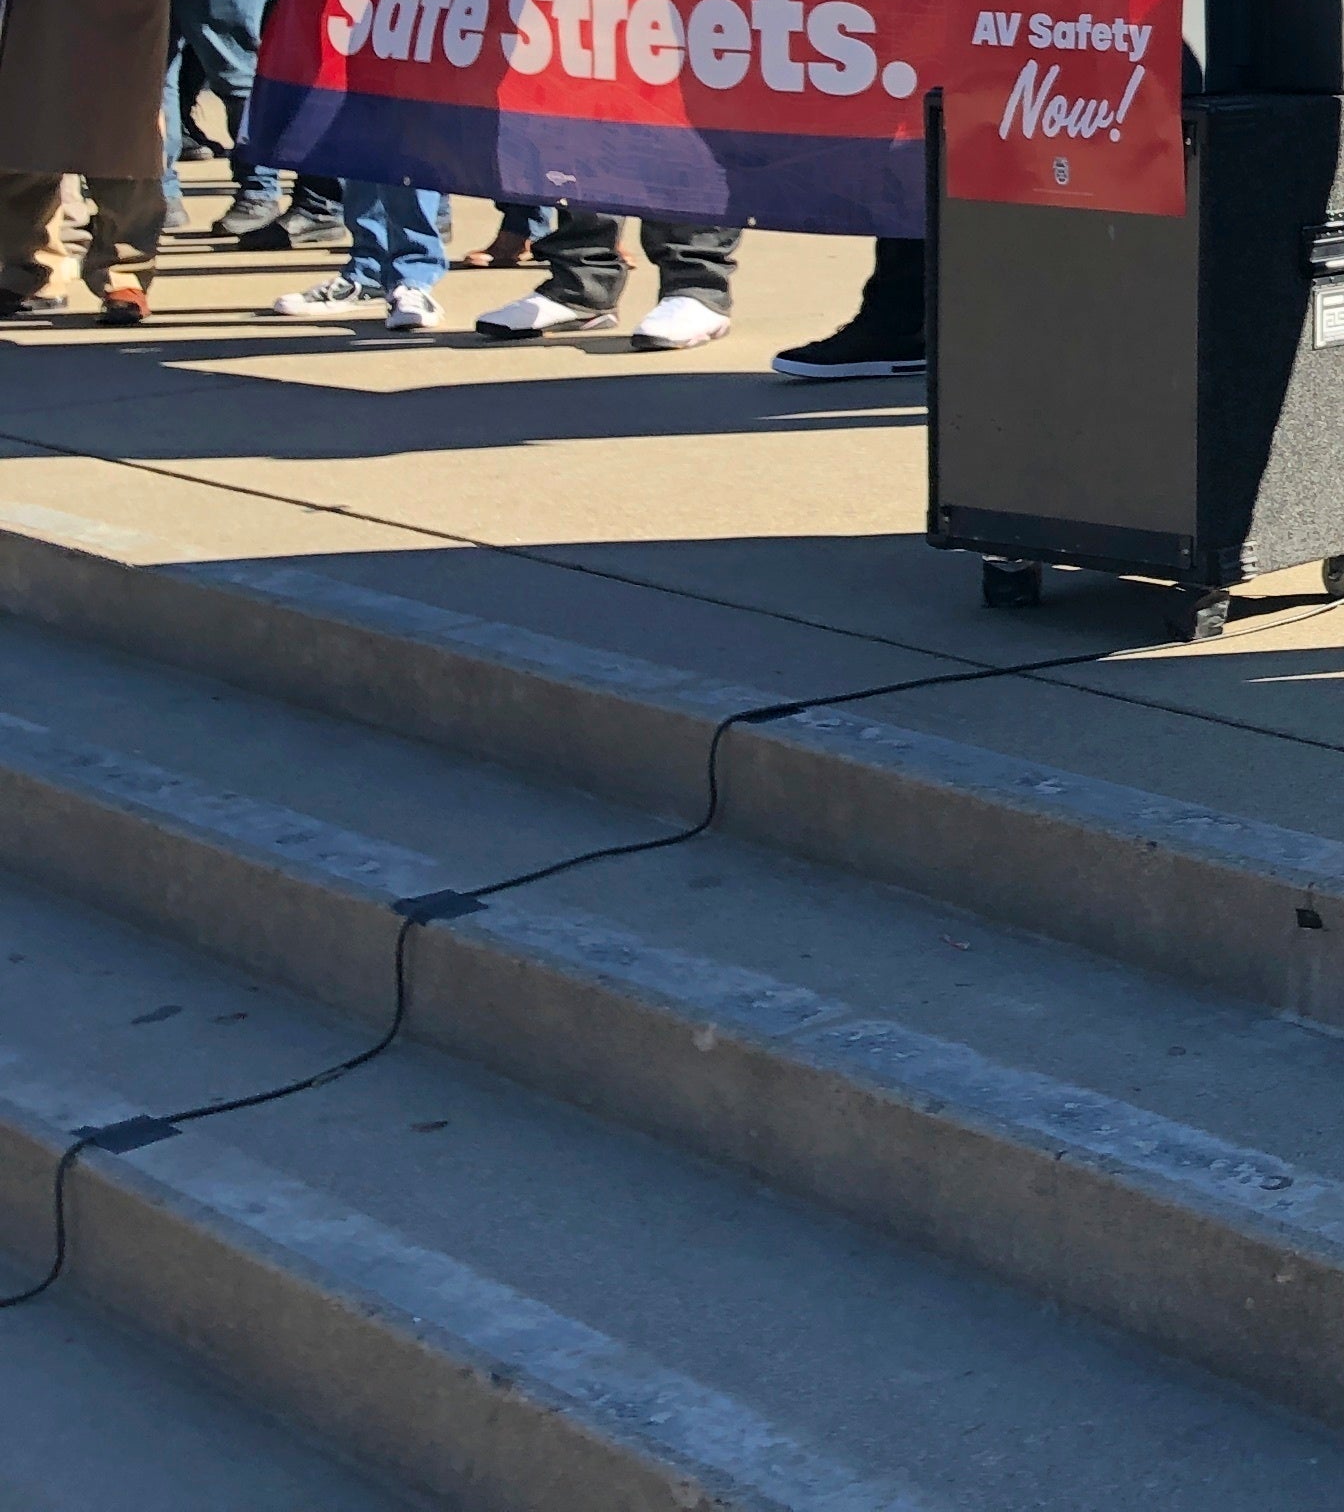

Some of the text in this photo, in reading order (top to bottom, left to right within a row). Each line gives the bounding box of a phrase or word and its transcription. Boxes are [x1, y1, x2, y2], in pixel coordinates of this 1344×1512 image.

[971, 11, 1153, 62] AV Safety
[998, 58, 1146, 143] Now!
